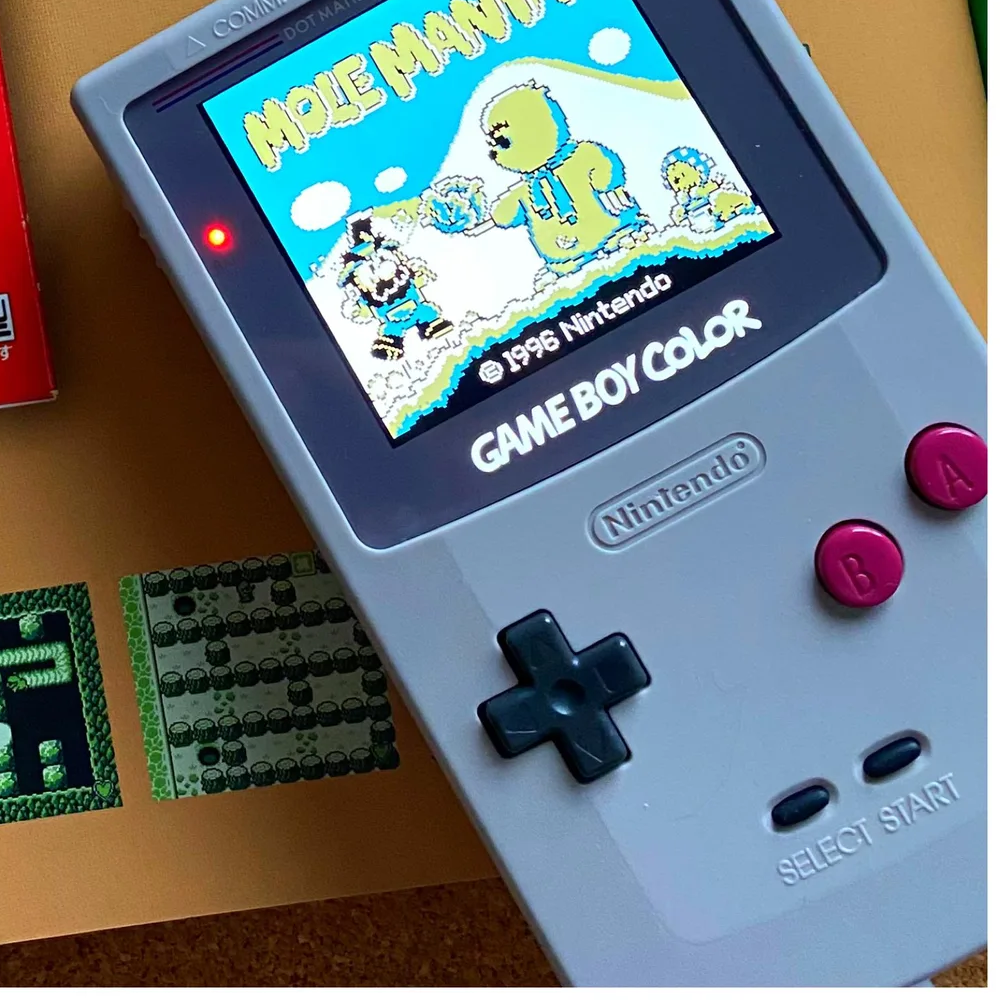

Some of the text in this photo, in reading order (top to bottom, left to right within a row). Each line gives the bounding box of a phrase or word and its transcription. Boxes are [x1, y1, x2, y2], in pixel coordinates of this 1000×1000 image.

[284, 14, 316, 41] DOT
[243, 53, 387, 173] MOLE
[502, 329, 561, 373] 1996
[558, 273, 673, 343] Nintendo
[470, 299, 763, 473] GAME BOY COLOR
[601, 449, 751, 538] Nintendo
[936, 451, 976, 501] A
[838, 552, 878, 600] B
[776, 771, 962, 887] SELECT START
